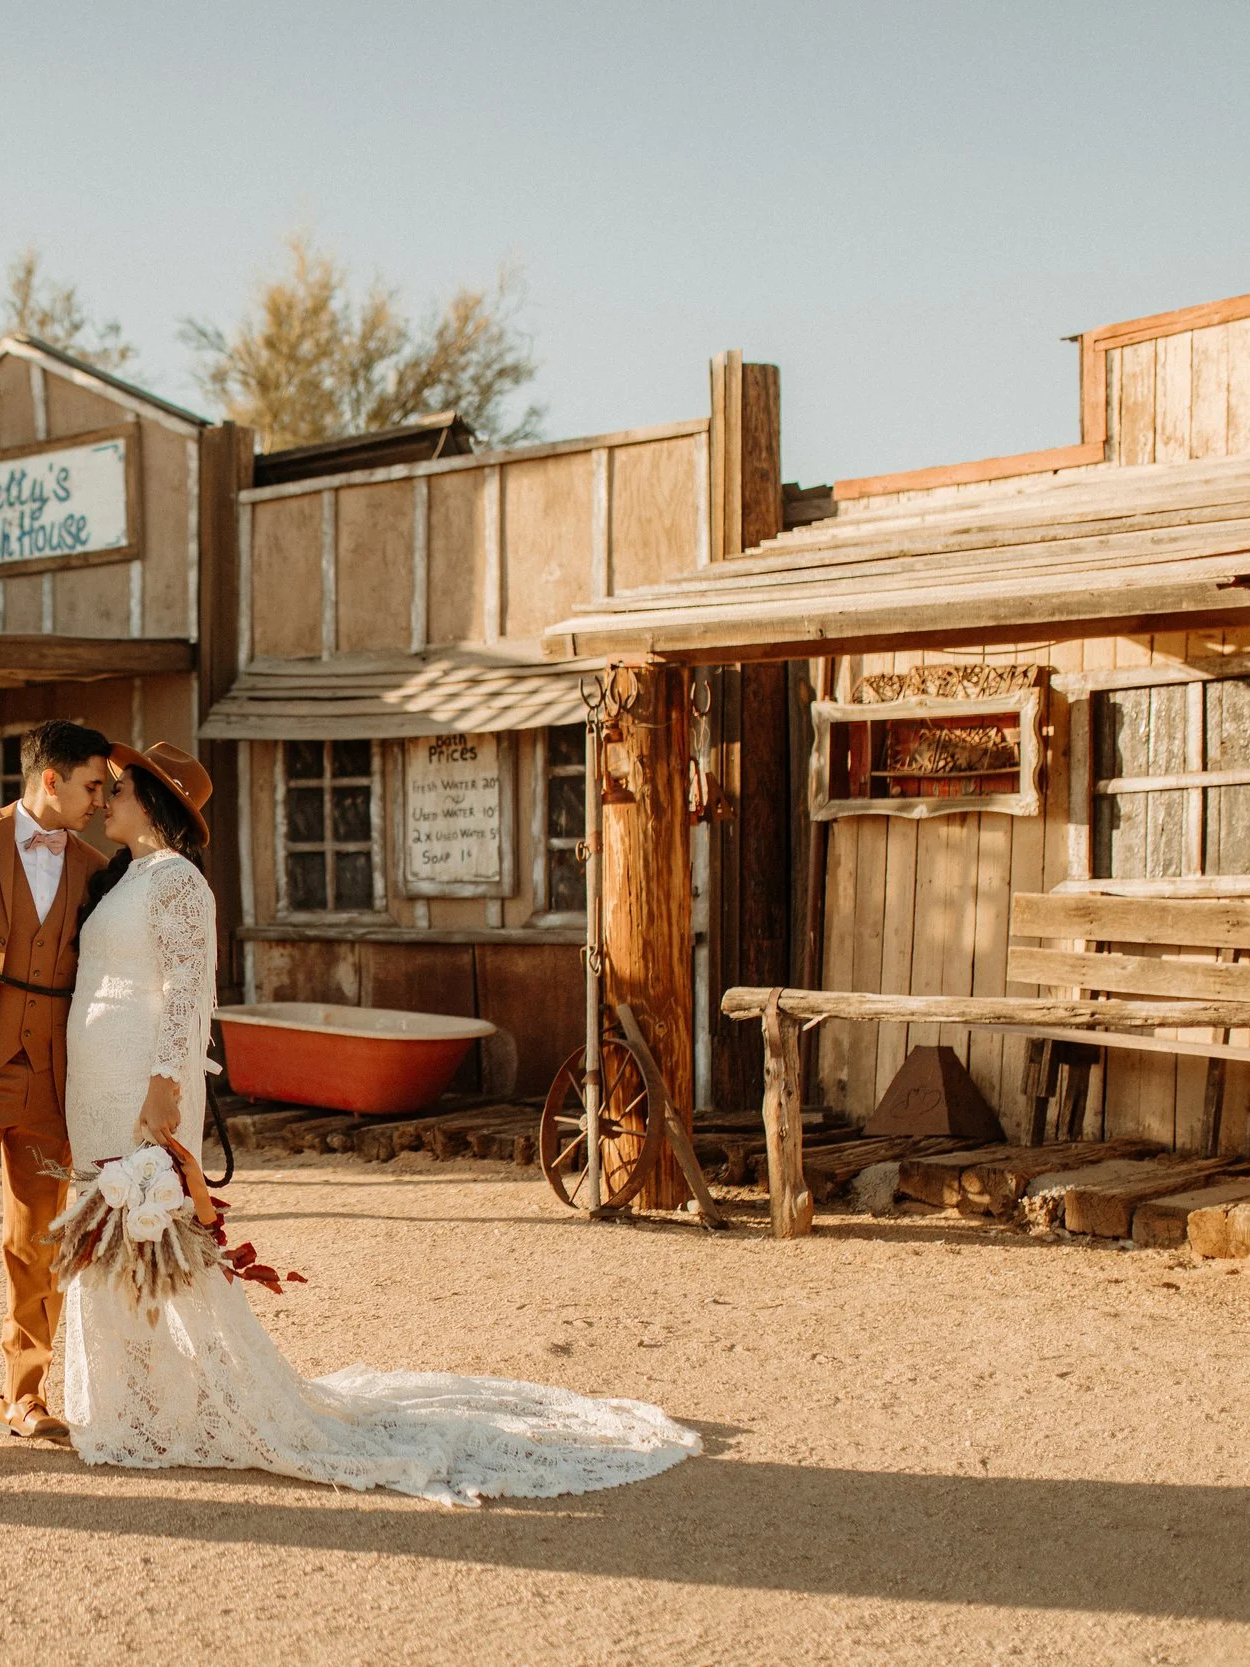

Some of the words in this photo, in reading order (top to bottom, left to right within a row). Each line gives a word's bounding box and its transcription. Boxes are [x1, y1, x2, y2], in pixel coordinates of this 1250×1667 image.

[17, 510, 92, 560] House
[436, 734, 467, 748] Bath
[428, 745, 478, 765] Prices
[412, 828, 422, 844] 2
